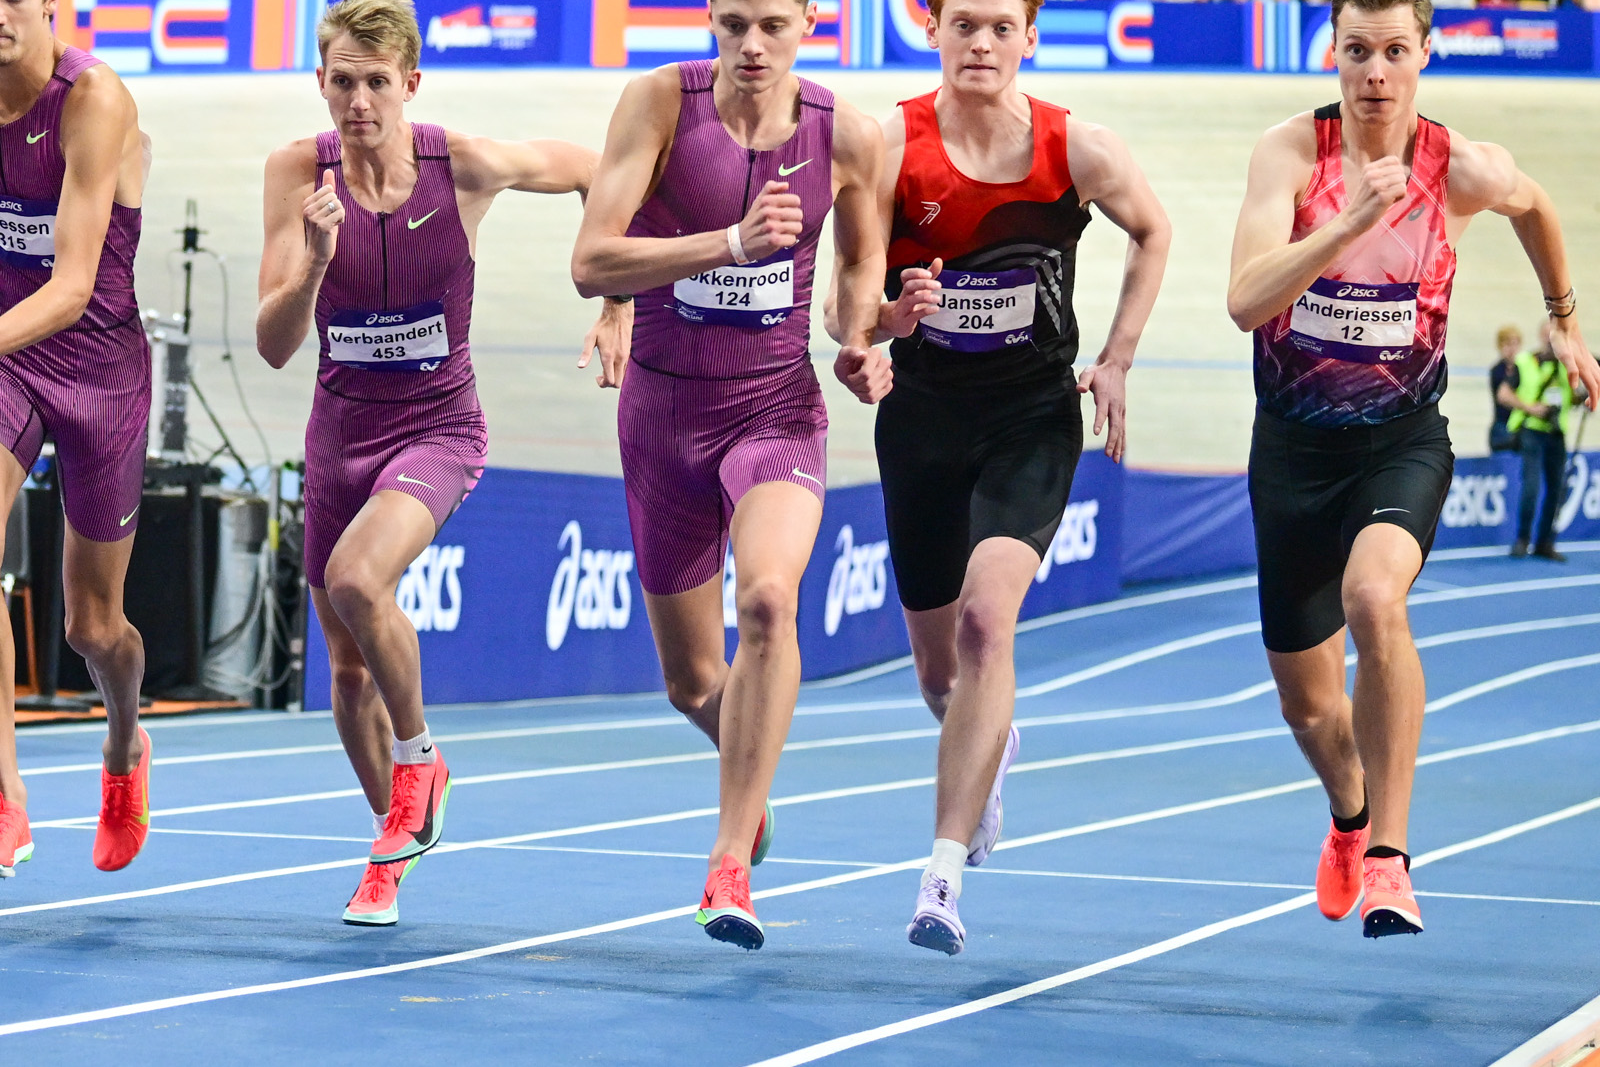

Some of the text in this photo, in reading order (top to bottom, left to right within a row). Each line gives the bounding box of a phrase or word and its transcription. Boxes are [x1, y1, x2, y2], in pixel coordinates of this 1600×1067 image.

[715, 291, 751, 307] 124
[937, 293, 1016, 310] Janssen
[1296, 294, 1412, 322] Anderiessen
[958, 314, 994, 330] 204
[331, 320, 443, 345] Verbaandert
[1341, 325, 1364, 341] 12
[372, 346, 406, 359] 453
